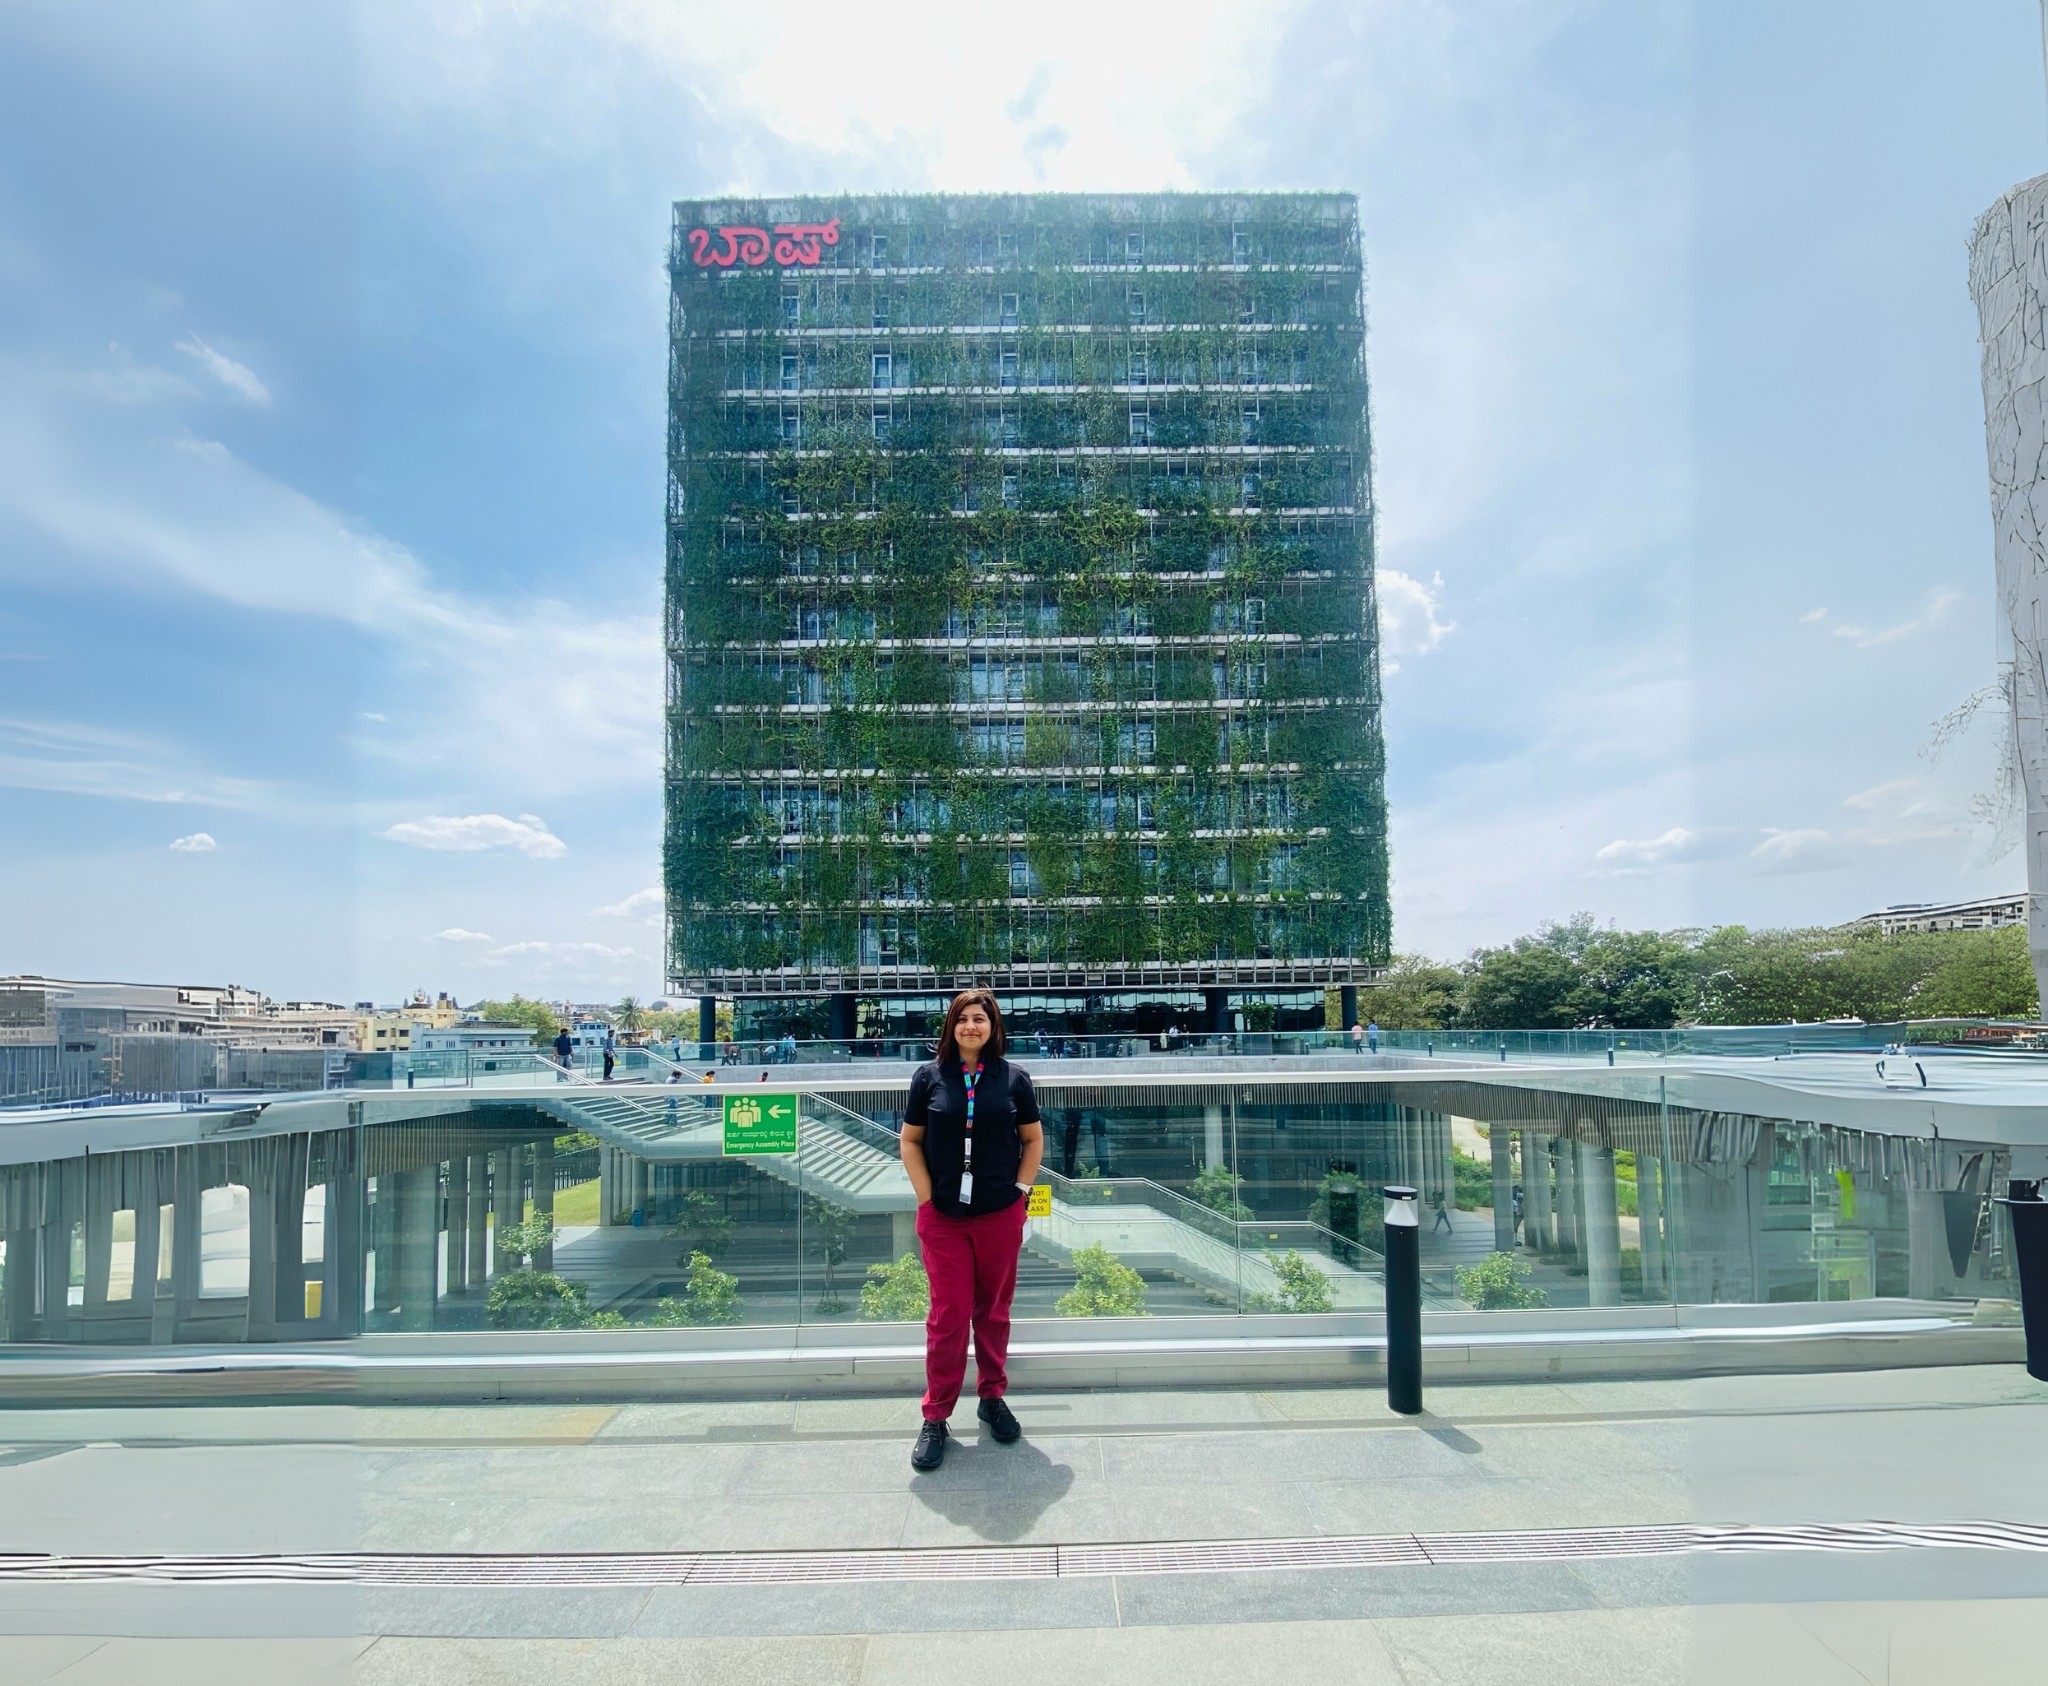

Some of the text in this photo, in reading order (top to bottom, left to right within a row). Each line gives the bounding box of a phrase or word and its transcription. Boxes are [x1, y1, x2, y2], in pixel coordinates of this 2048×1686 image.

[688, 217, 841, 267] ಬಾಷ್
[726, 1142, 754, 1150] Emergency
[755, 1141, 780, 1149] Assembly
